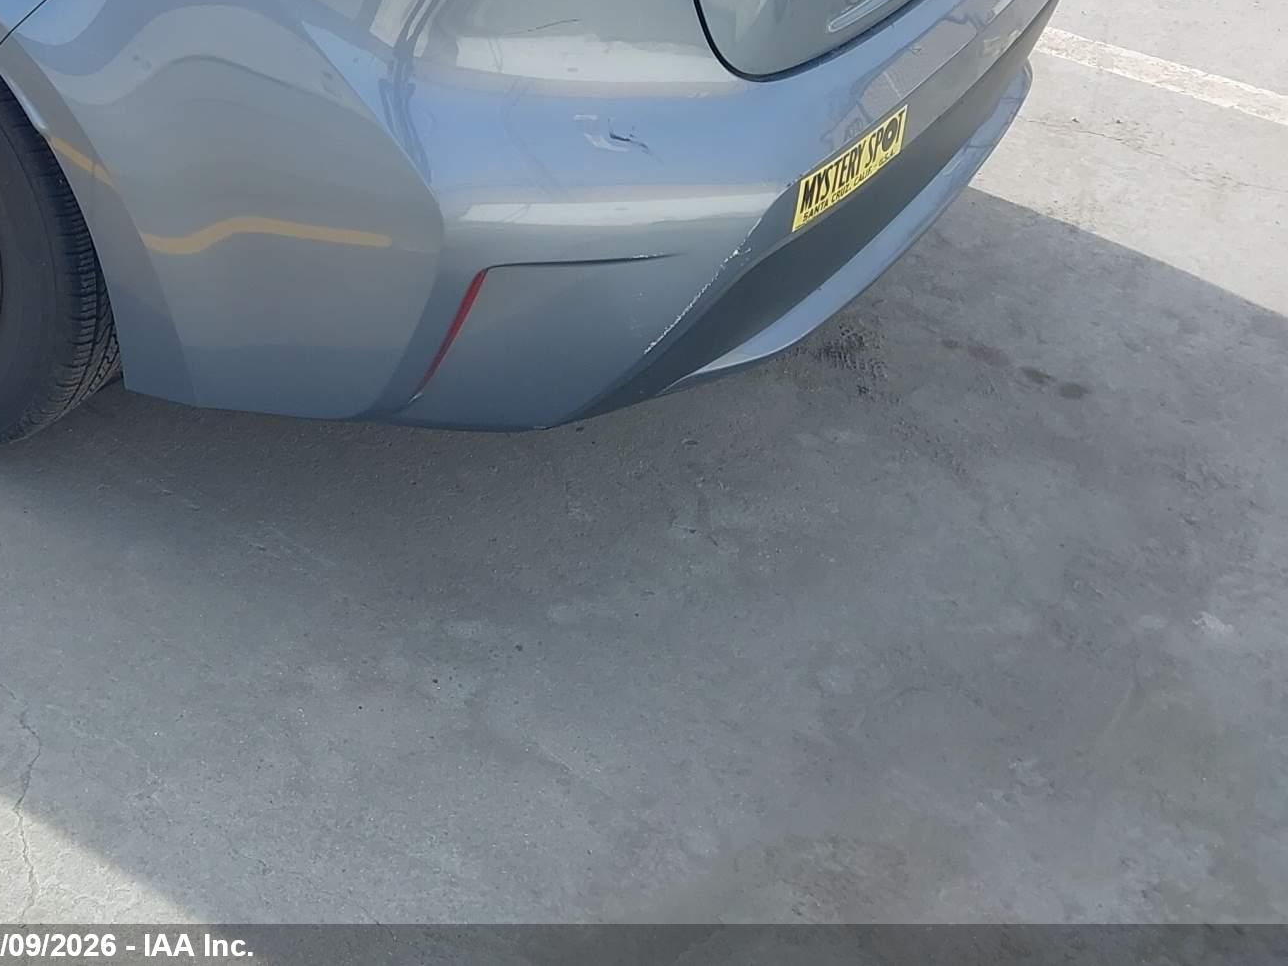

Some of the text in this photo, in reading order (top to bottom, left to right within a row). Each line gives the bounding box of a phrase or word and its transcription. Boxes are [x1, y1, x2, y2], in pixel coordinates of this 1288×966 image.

[800, 111, 905, 214] MYSTERY SPOT
[802, 199, 829, 222] SANTA
